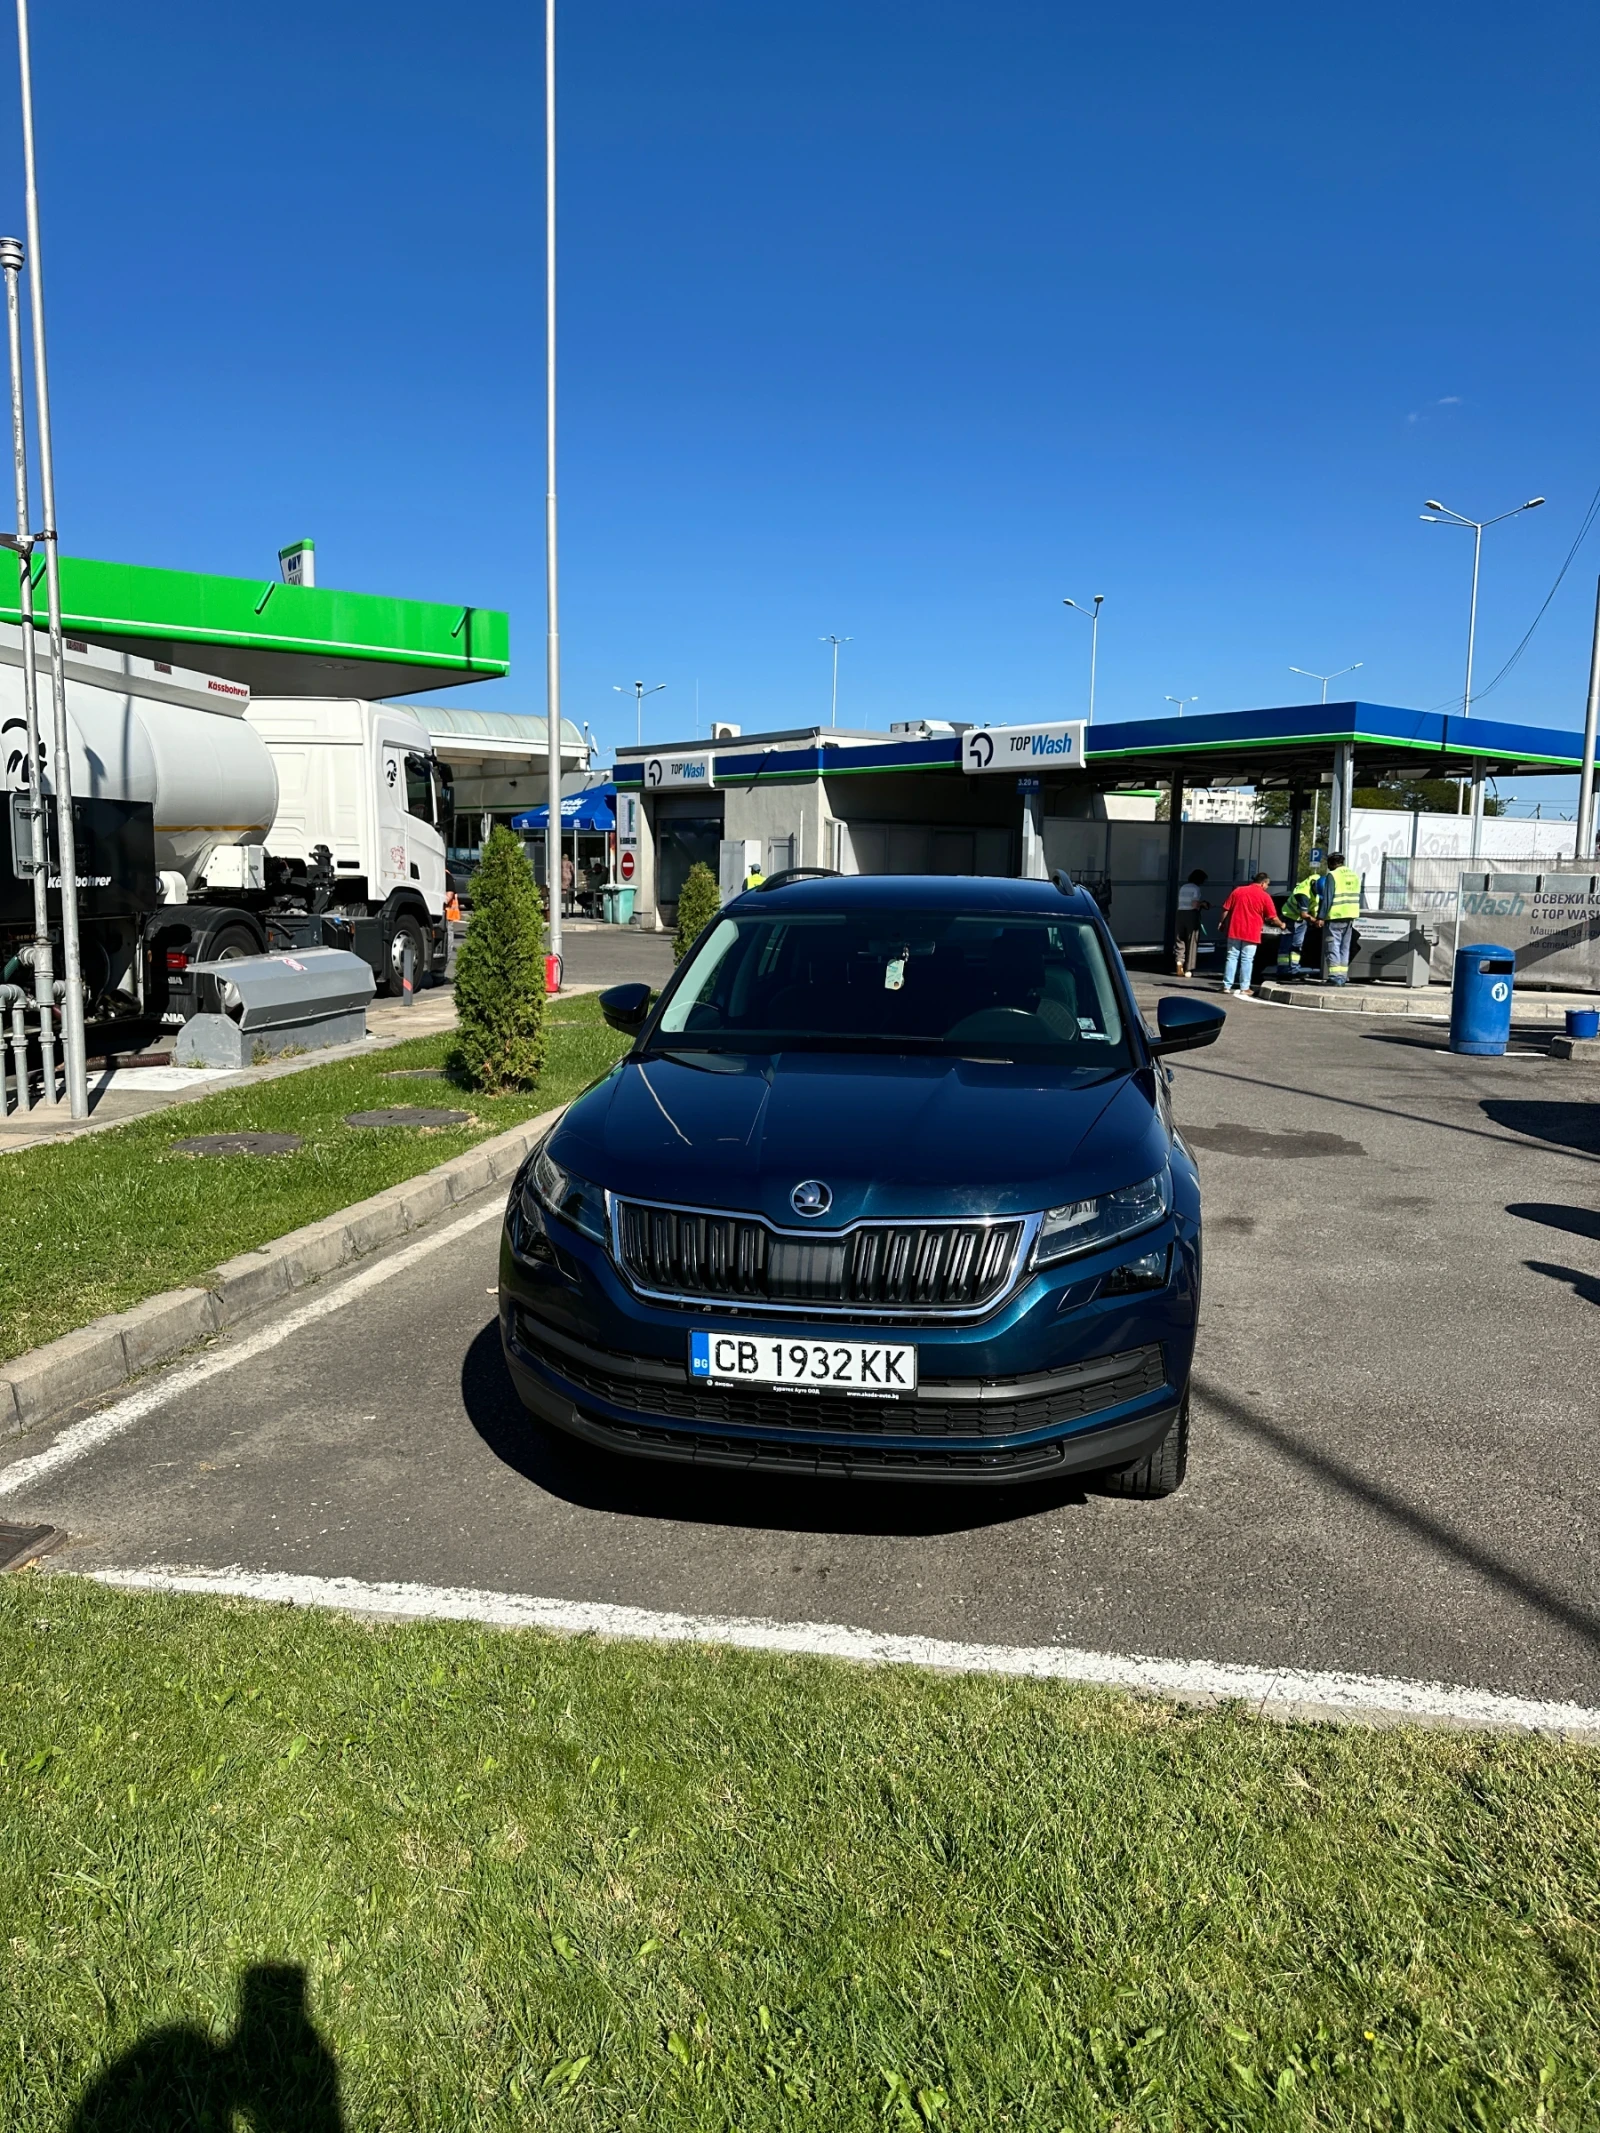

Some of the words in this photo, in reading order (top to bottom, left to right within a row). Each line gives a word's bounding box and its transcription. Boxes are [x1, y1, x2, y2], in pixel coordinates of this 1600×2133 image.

[208, 680, 248, 697] Kässbohrer
[1312, 850, 1319, 861] P
[47, 876, 111, 888] Käbohrer
[1534, 893, 1585, 905] ОСВЕЖИ
[1542, 909, 1564, 920] TOP
[1530, 925, 1568, 936] Машина
[694, 1358, 708, 1369] BG
[715, 1340, 759, 1374] CB
[771, 1344, 853, 1381] 1932
[861, 1350, 906, 1384] KK
